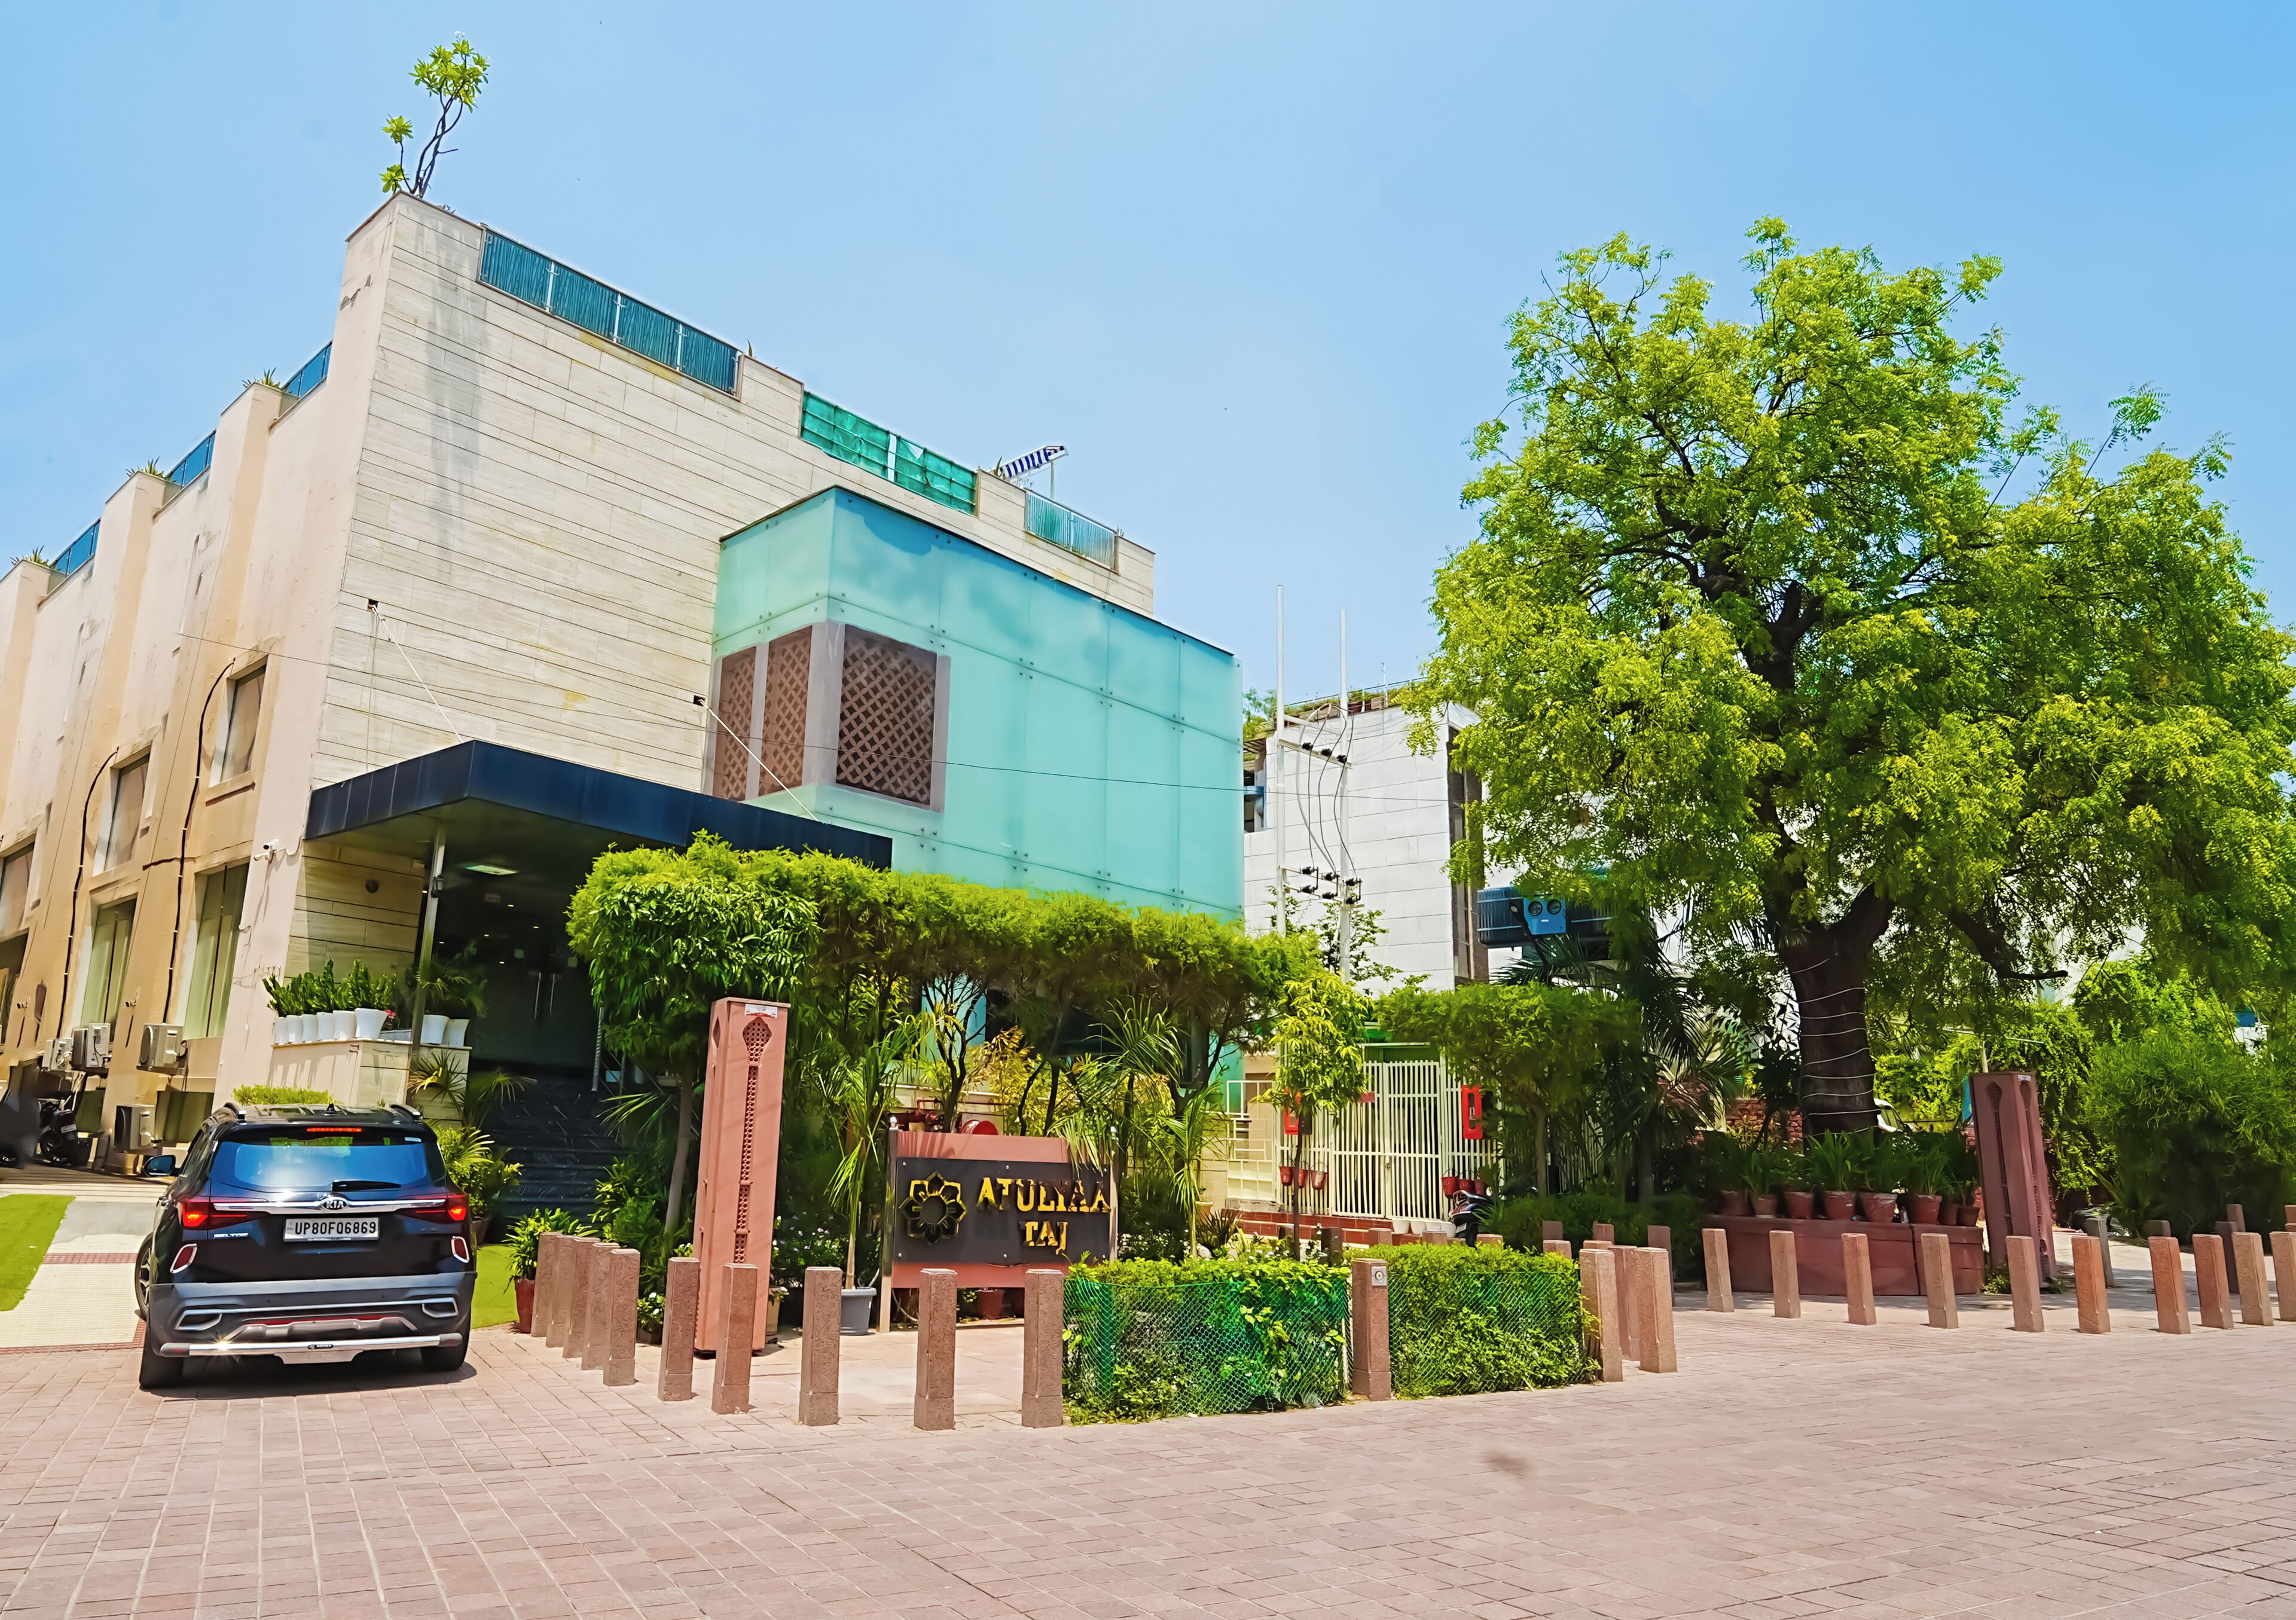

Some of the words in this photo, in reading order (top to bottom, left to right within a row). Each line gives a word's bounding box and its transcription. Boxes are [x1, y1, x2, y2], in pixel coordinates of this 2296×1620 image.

[326, 1200, 344, 1209] KIA
[295, 1222, 377, 1235] UP80FQ6869
[1018, 1221, 1068, 1255] TAJ
